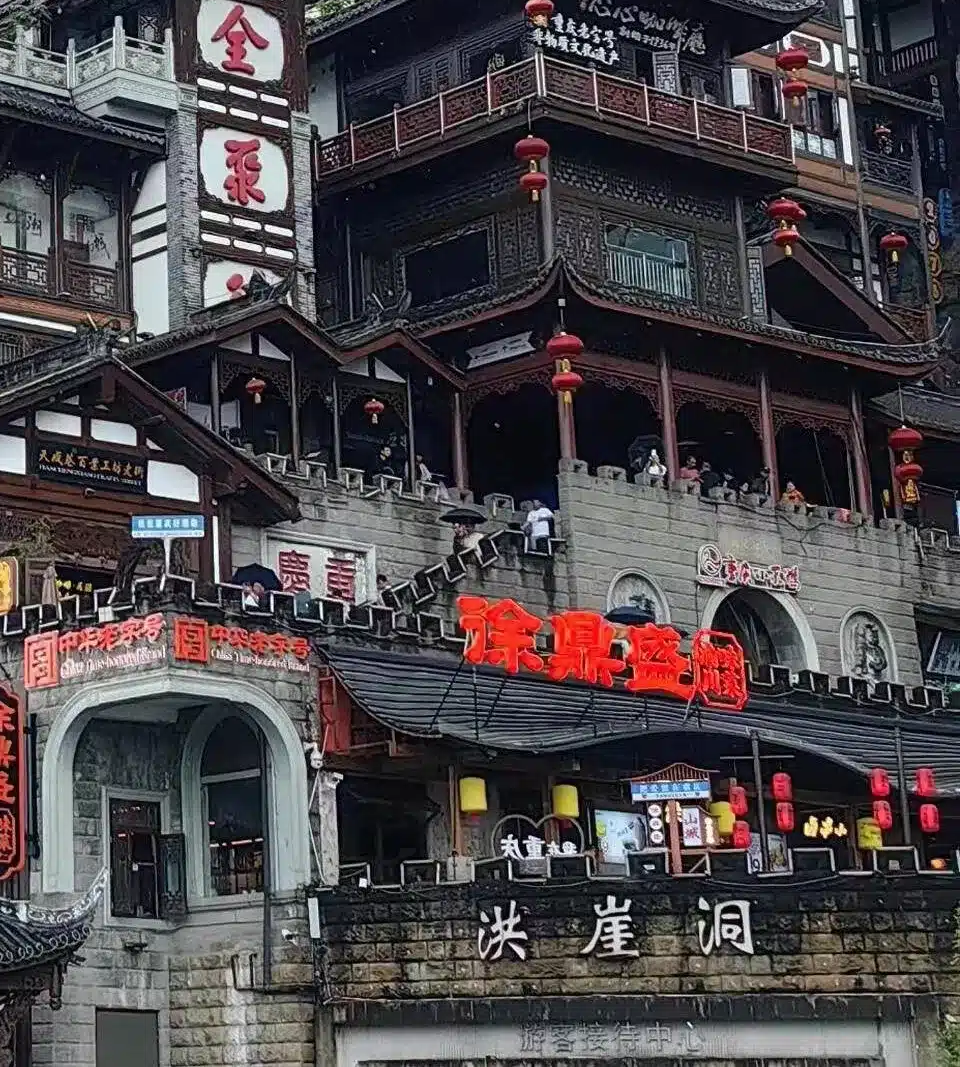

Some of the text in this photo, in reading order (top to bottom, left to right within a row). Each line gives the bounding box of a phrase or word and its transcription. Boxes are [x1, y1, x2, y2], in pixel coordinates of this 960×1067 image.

[531, 27, 621, 66] 非物质文化遗产
[551, 12, 617, 50] 重庆老字号
[57, 612, 166, 653] 中华老字号
[210, 626, 312, 660] 中华老字号
[455, 596, 695, 701] 徐鼎盛
[477, 895, 755, 962] 洪崖洞
[520, 1020, 707, 1054] 游客接待中心
